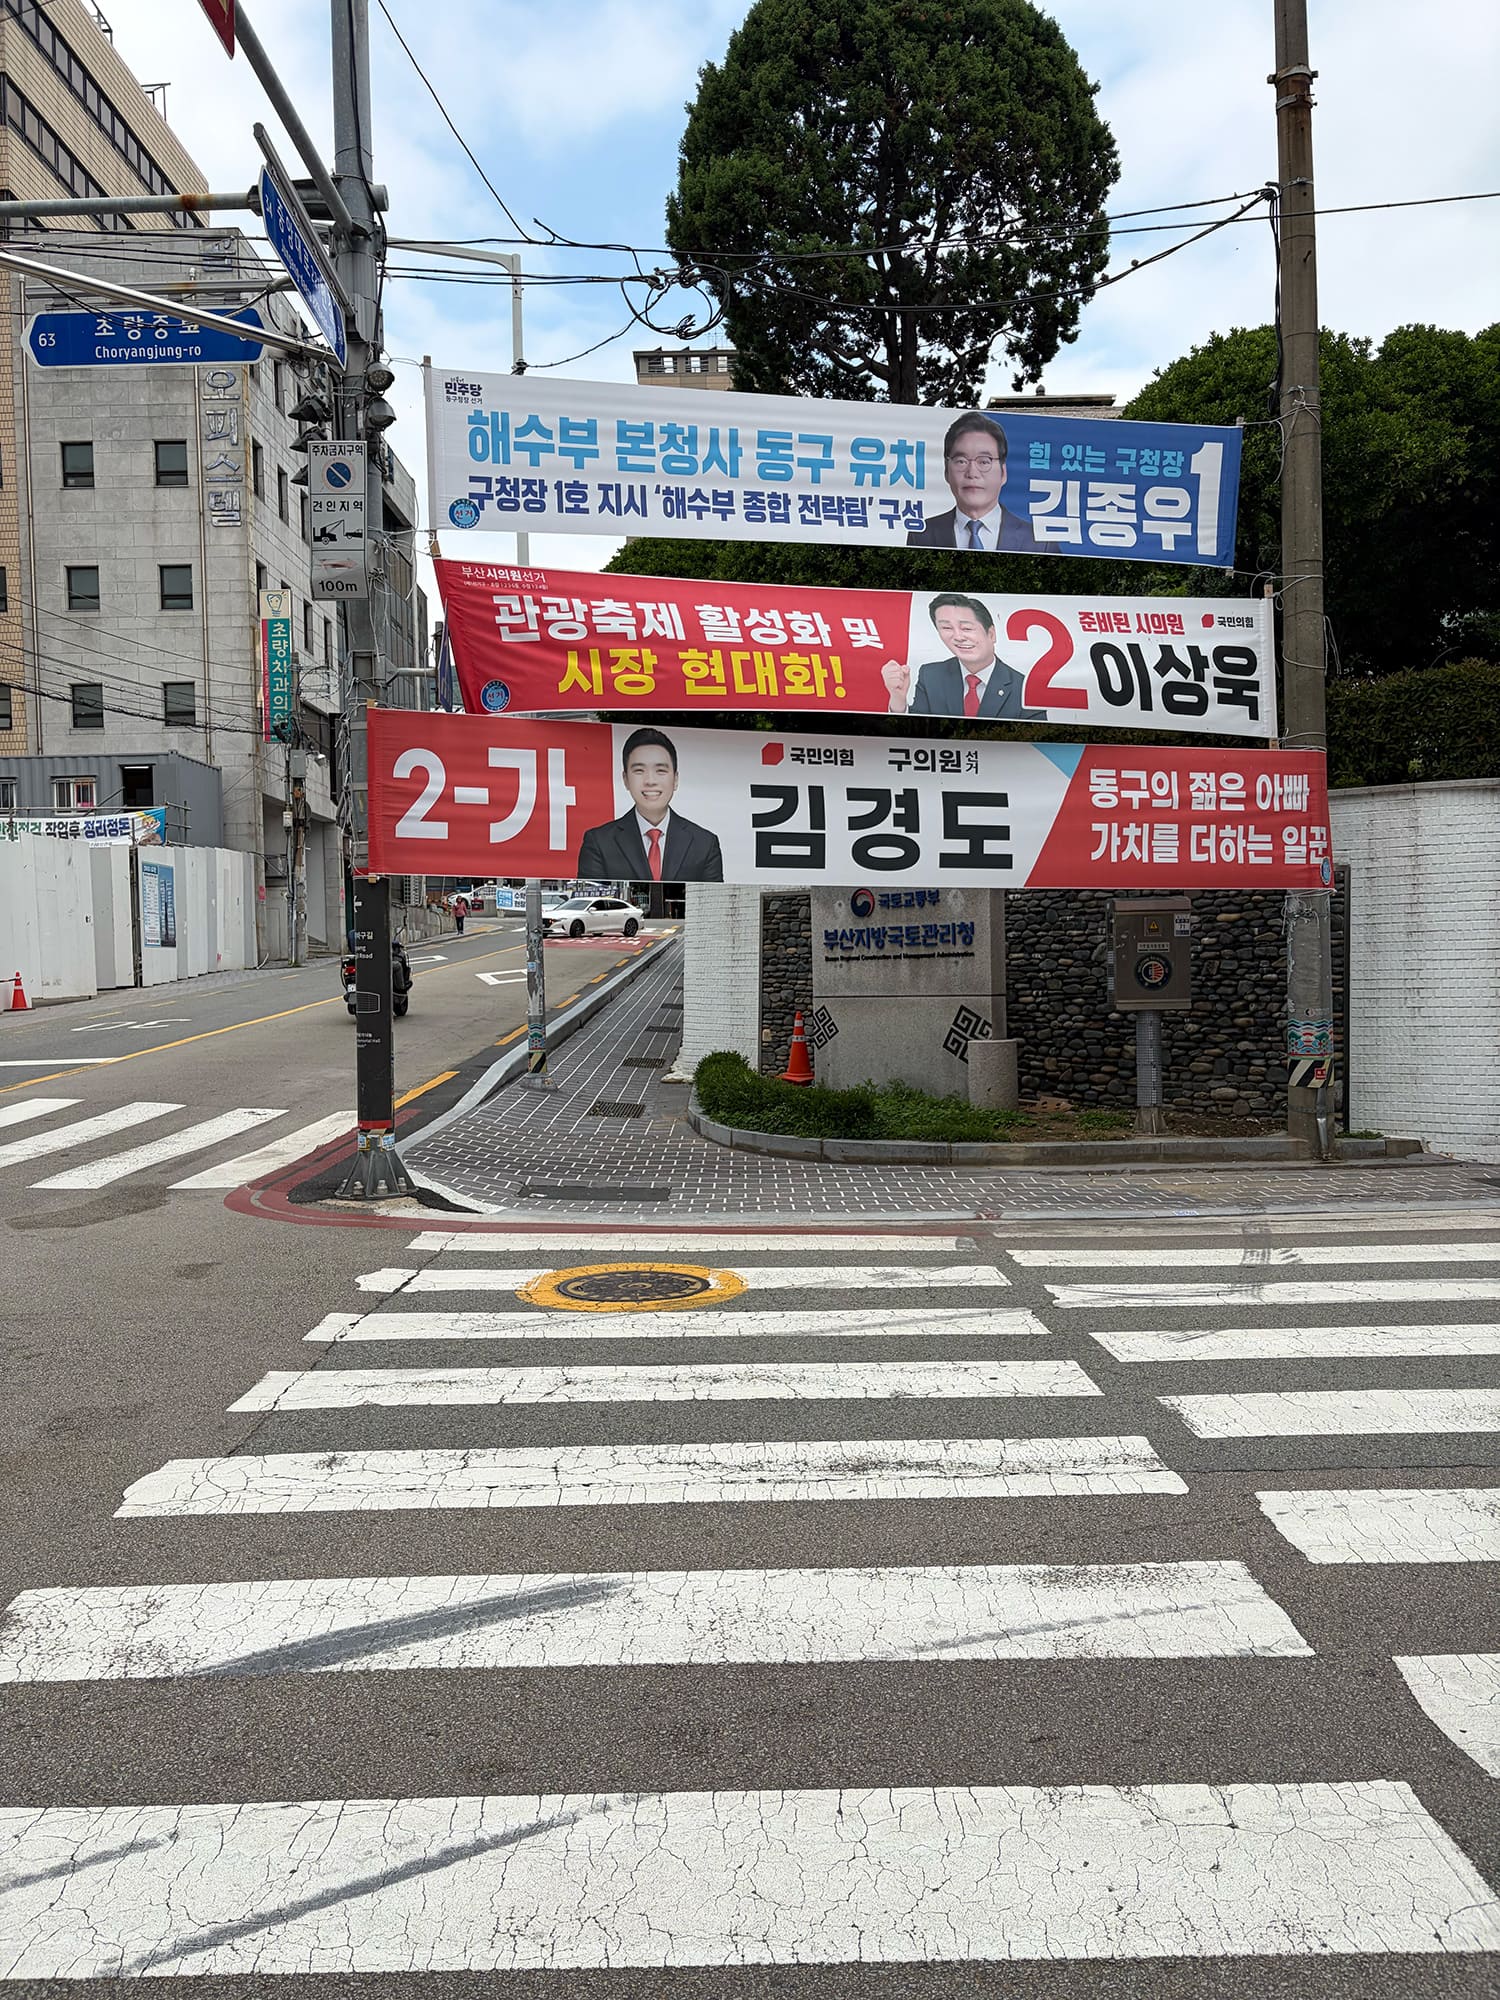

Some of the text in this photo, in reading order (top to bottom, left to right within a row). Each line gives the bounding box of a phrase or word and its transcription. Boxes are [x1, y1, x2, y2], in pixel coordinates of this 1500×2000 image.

[38, 333, 56, 347] 63
[95, 346, 201, 360] Choryangjung-ro
[444, 382, 483, 397] 민주당
[202, 370, 243, 528] 오피스텔
[312, 444, 363, 457] 주차금지구역
[467, 409, 926, 490] 해수부 본청사 동구 유치
[1029, 441, 1184, 478] 힘 있는 구청장
[468, 475, 548, 514] 구청장
[554, 480, 590, 515] 1호
[597, 483, 648, 518] 지시
[743, 490, 791, 525] 종합
[879, 498, 926, 532] 구성
[1029, 479, 1192, 551] 김종우
[1190, 442, 1224, 556] 1
[319, 581, 358, 593] 100m
[494, 594, 884, 650] 관광축제 활성화 및
[1078, 611, 1186, 636] 준비된 시의원
[1217, 616, 1254, 629] 국민의힘
[558, 648, 847, 699] 시장 현대화!
[1006, 608, 1089, 710] 2
[1089, 642, 1260, 721] 이상욱
[790, 747, 979, 775] 국민의힘 구의원 선거
[393, 747, 577, 851] 2-가
[1088, 768, 1310, 813] 동구의 젊은 아빠
[45, 821, 81, 840] 작업후
[84, 817, 131, 839] 정리정돈
[750, 783, 1013, 871] 김경도
[1090, 822, 1328, 865] 가치를 더하는 일꾼
[823, 921, 975, 951] 부산지방국토관리청
